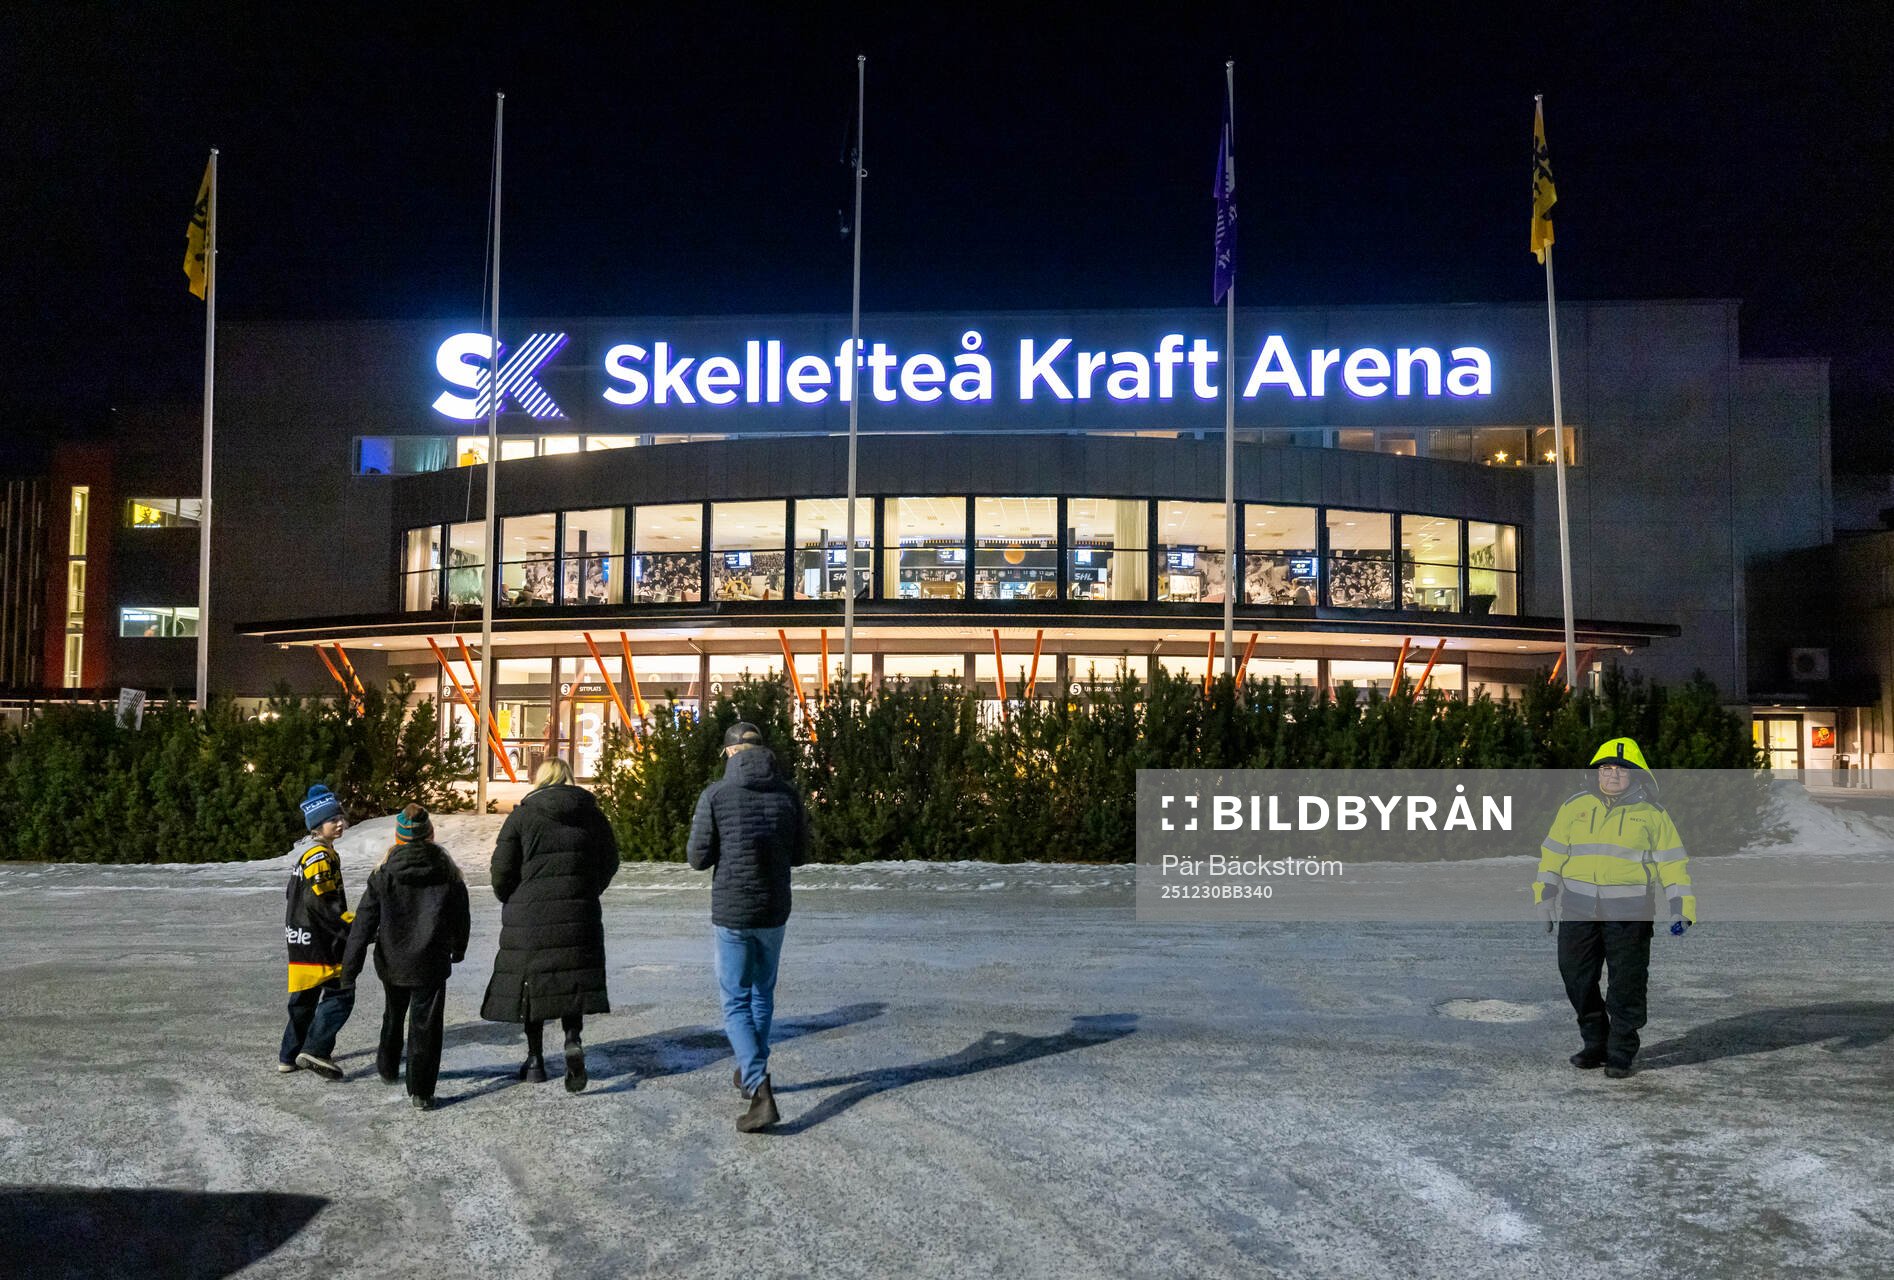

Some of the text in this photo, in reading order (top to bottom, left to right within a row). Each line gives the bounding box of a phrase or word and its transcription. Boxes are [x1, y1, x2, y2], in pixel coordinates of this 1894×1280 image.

[431, 330, 567, 422] SK
[601, 330, 1492, 406] Skellefteå Kraft Arena
[578, 712, 601, 754] 3
